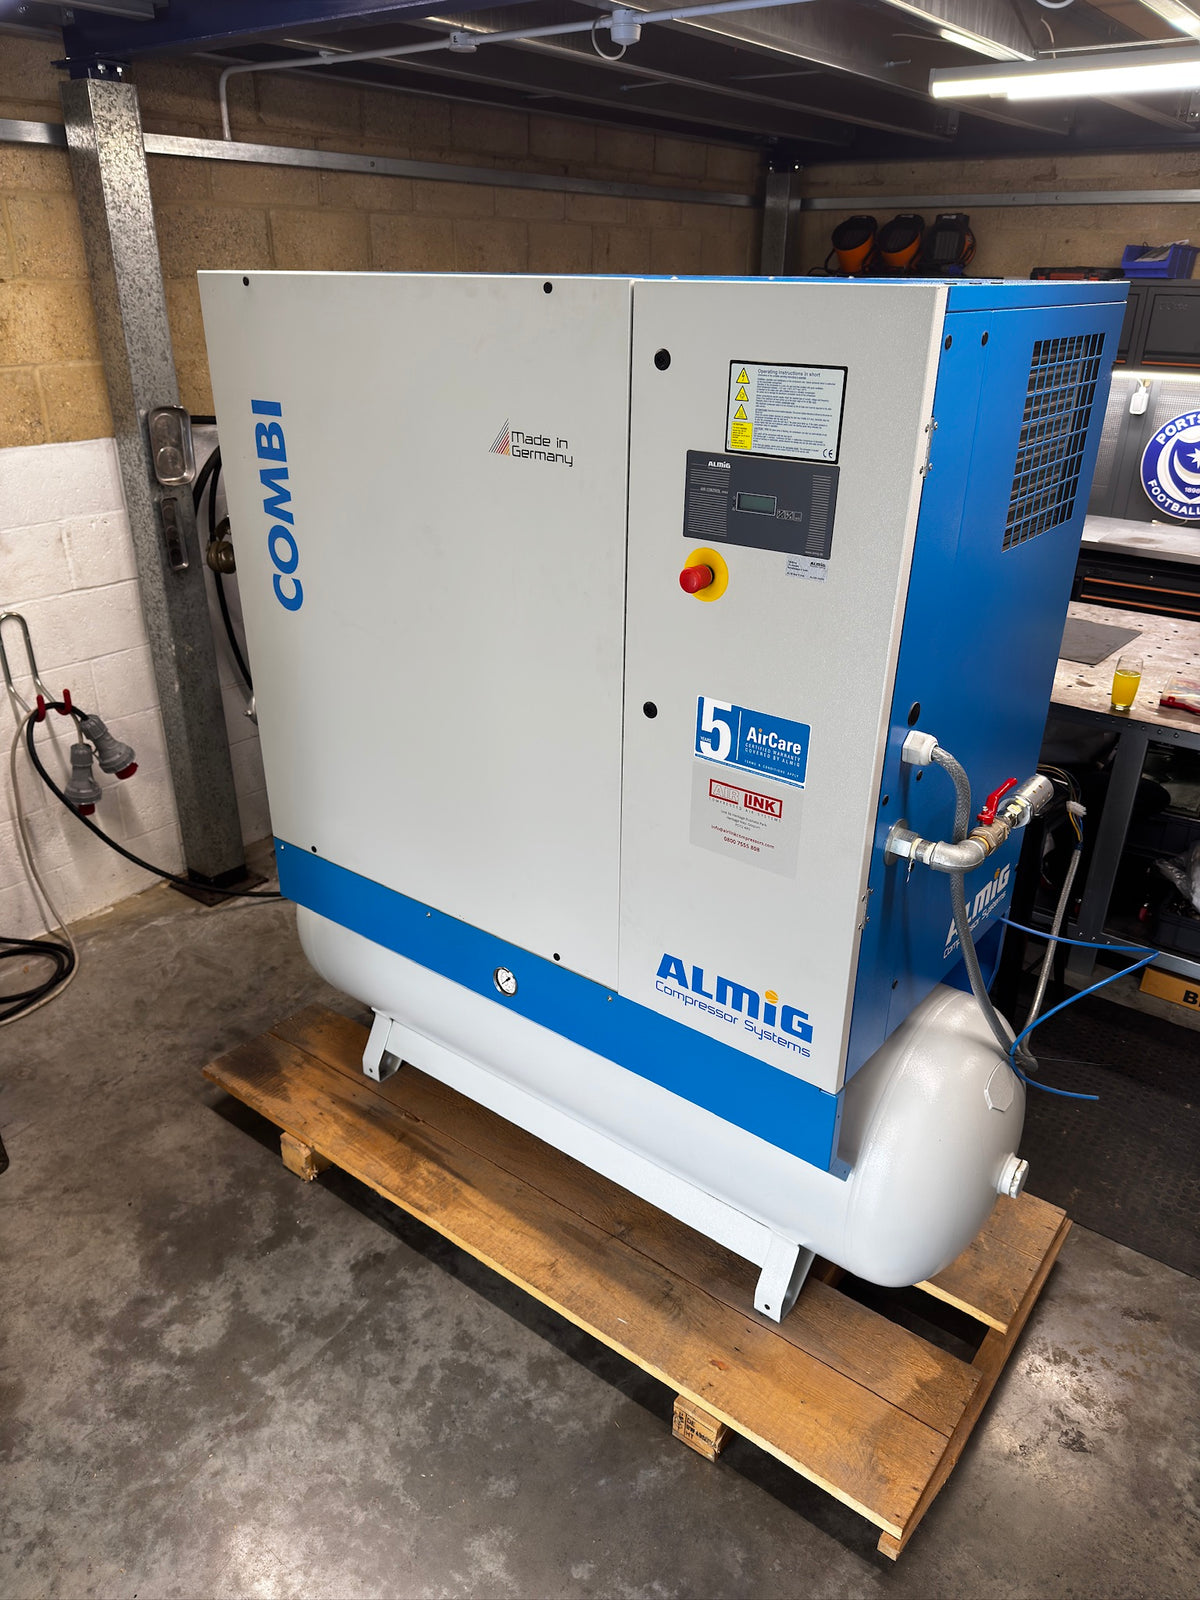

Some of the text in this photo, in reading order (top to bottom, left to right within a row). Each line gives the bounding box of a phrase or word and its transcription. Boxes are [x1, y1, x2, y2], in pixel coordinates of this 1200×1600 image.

[511, 431, 568, 449] Made in
[511, 445, 573, 467] Germany
[251, 399, 304, 611] COMBI
[701, 697, 731, 761] 5
[746, 726, 802, 755] AirCare
[744, 742, 801, 762] CERTIFIED WARRANTY
[744, 747, 771, 759] COVERED
[781, 758, 800, 768] ALMIG
[713, 784, 740, 803] AIR
[723, 836, 736, 845] 0800
[737, 840, 749, 849] 7555
[655, 980, 811, 1058] Compressor Systems
